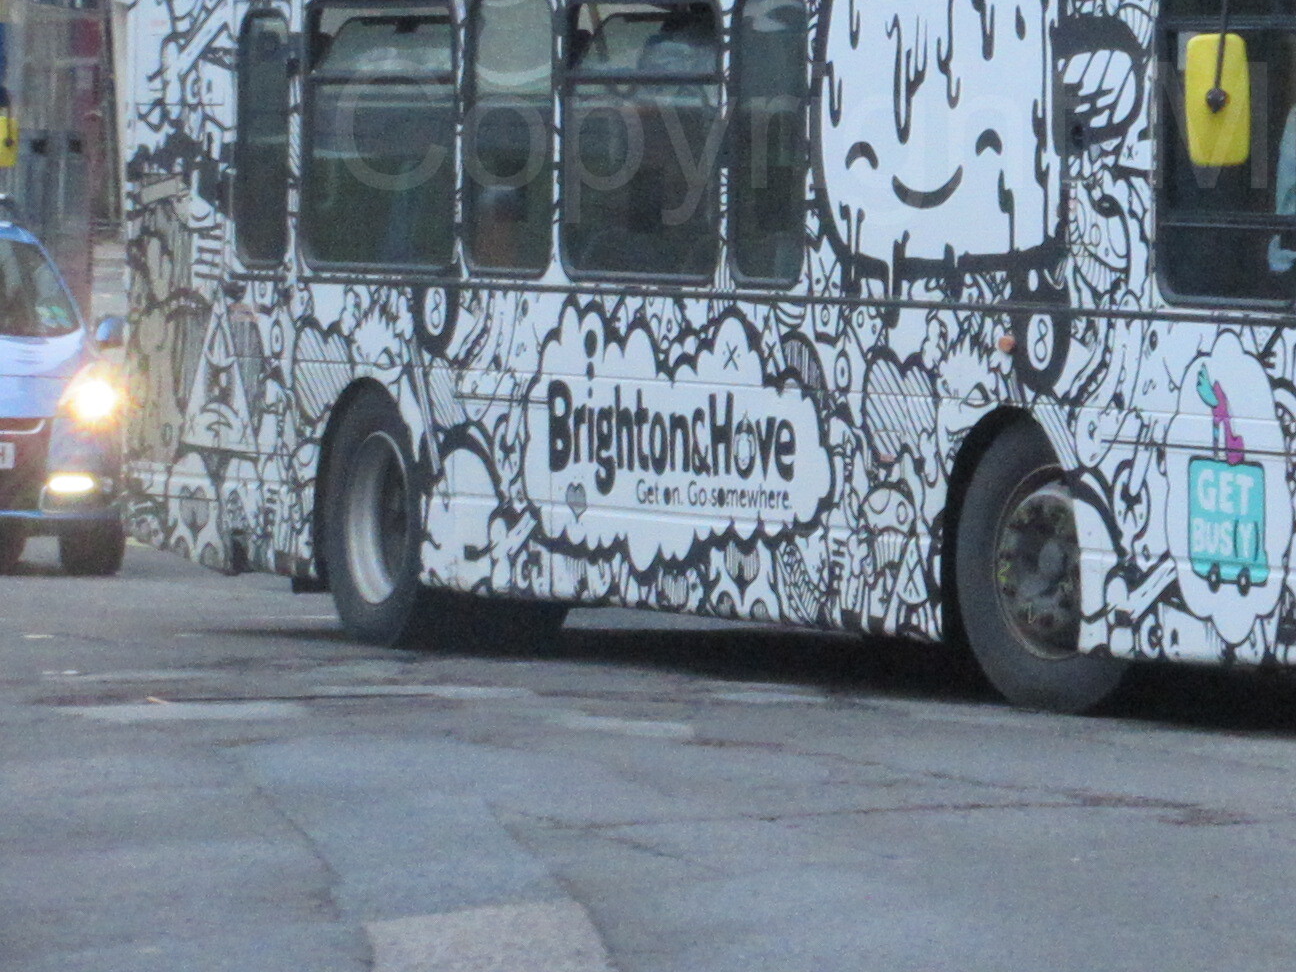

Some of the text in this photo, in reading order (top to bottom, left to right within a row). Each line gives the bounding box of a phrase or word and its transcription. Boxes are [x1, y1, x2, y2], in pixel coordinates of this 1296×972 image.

[636, 478, 659, 505] Get
[687, 479, 707, 506] Go
[1197, 469, 1254, 515] GET
